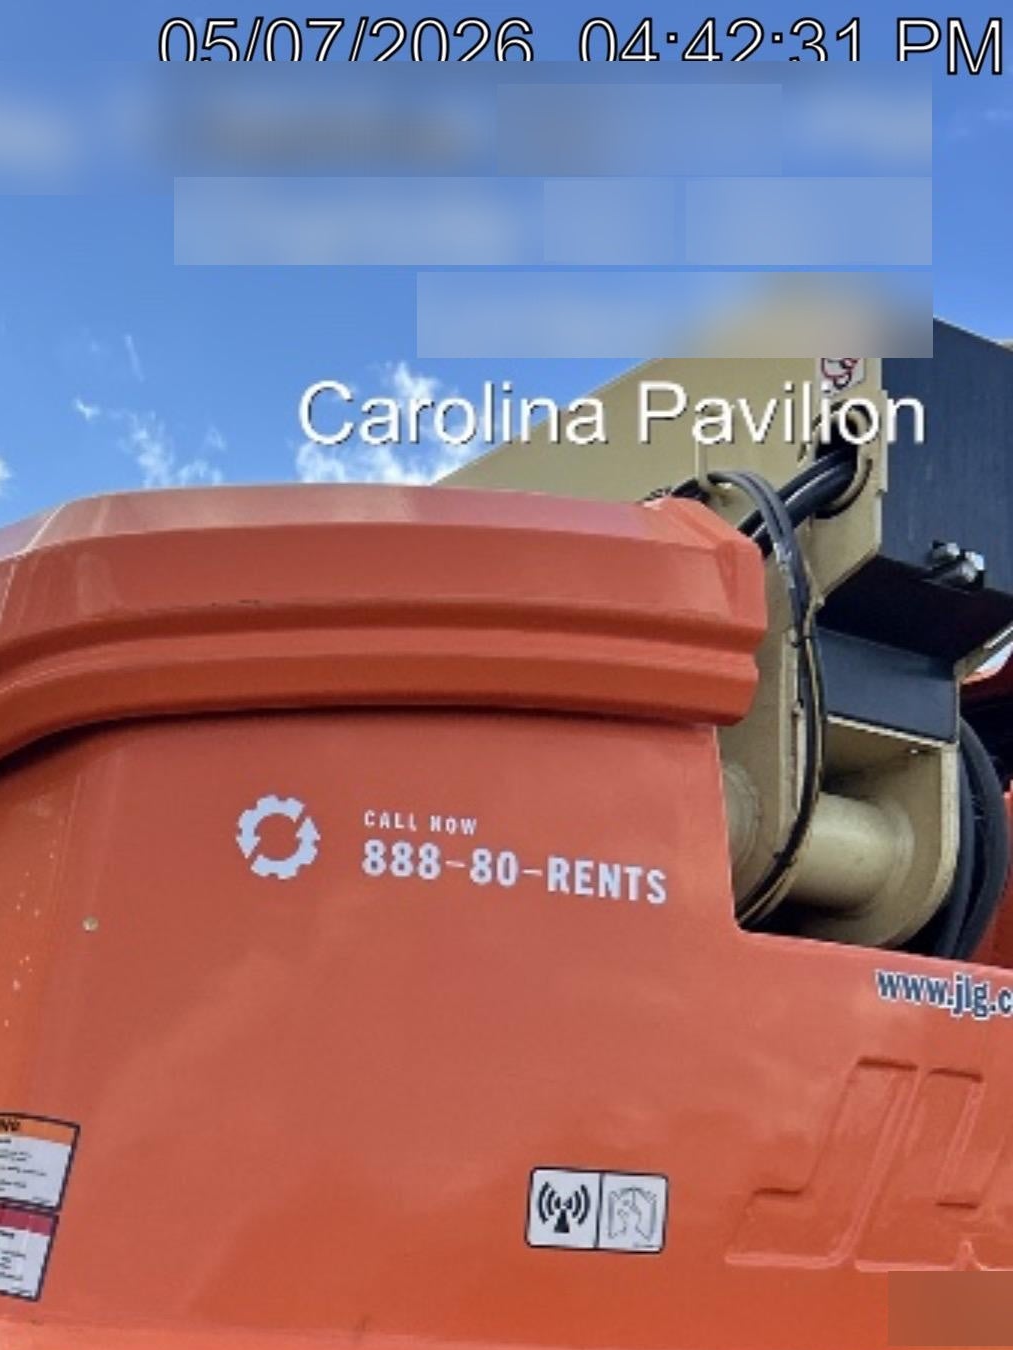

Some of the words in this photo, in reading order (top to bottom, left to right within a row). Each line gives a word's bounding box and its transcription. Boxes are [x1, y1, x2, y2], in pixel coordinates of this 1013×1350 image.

[364, 809, 418, 833] CALL
[429, 814, 477, 836] NOW
[361, 839, 668, 905] 888-80-RENTS
[876, 969, 1013, 1020] www.jlg.c
